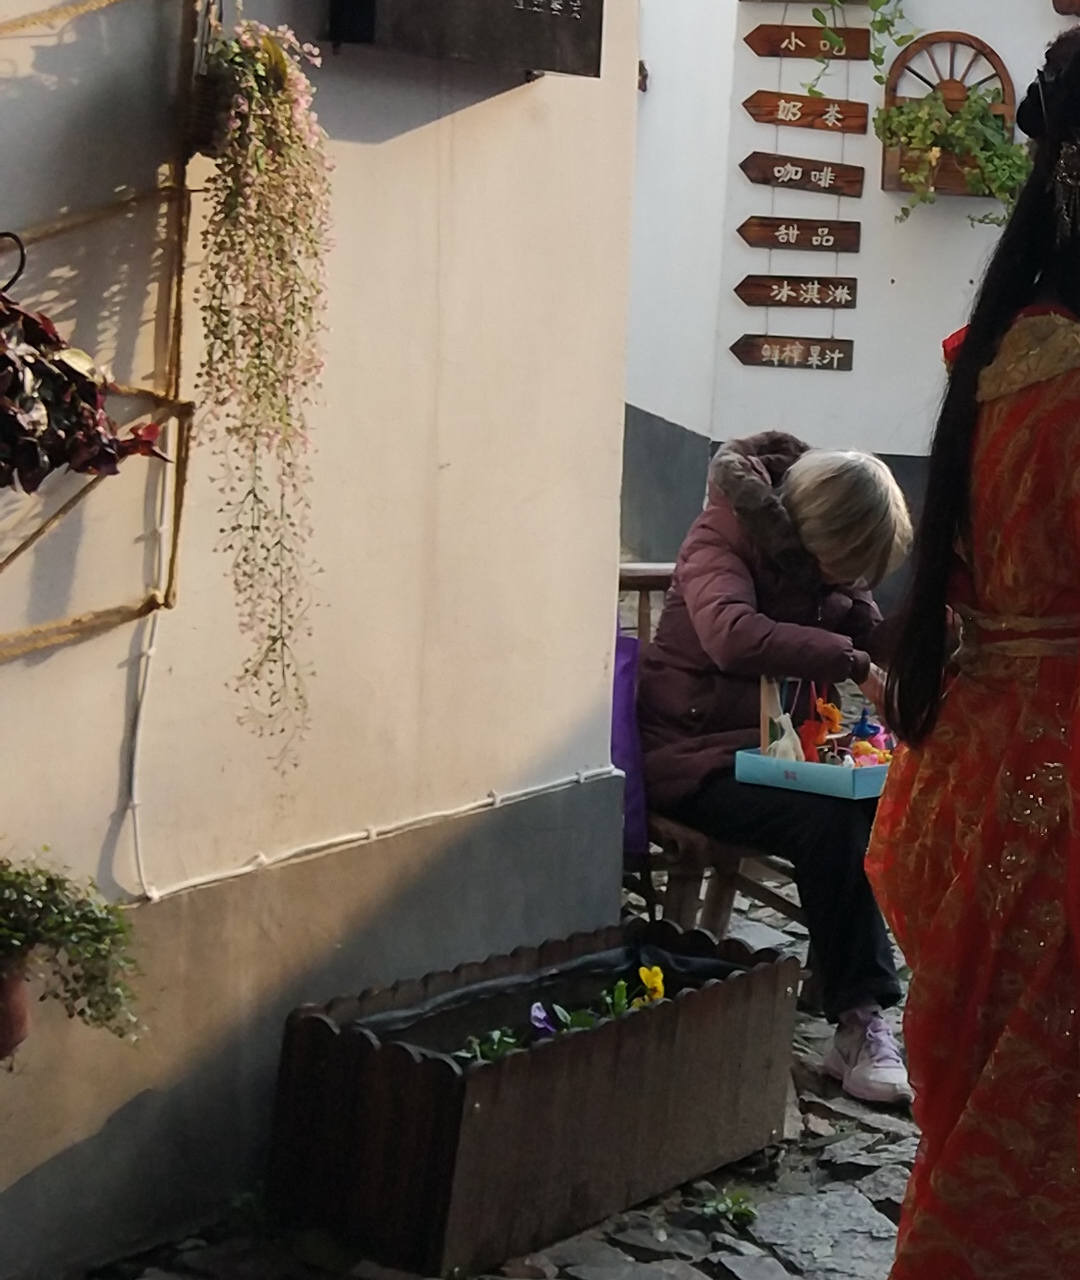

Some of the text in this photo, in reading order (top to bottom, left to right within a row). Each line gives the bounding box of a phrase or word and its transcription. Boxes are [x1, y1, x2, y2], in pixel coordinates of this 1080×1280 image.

[780, 31, 847, 56] 小吃
[776, 99, 844, 127] 奶茶
[773, 162, 837, 188] 咖啡
[774, 223, 835, 246] 甜品
[769, 280, 853, 304] 冰淇淋
[760, 341, 845, 370] 鲜榨果汁
